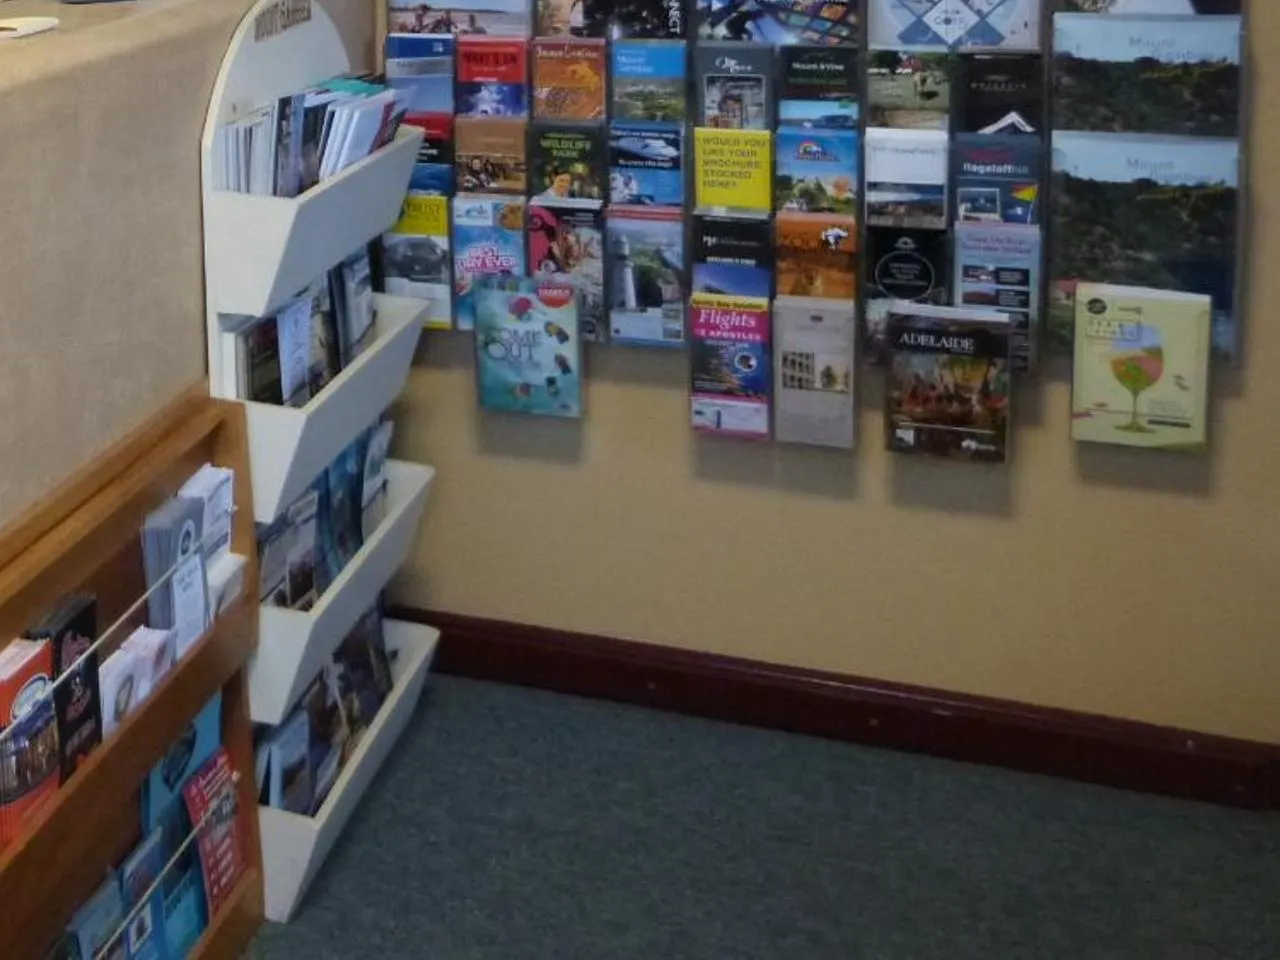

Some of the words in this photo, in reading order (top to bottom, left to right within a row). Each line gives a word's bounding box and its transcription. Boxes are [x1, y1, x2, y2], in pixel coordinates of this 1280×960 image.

[539, 138, 593, 151] WILDLIFE
[702, 136, 741, 146] WOULD
[727, 147, 758, 158] YOUR
[702, 169, 753, 179] STOCKED
[699, 308, 757, 331] Flights
[899, 332, 975, 350] ADELAIDE
